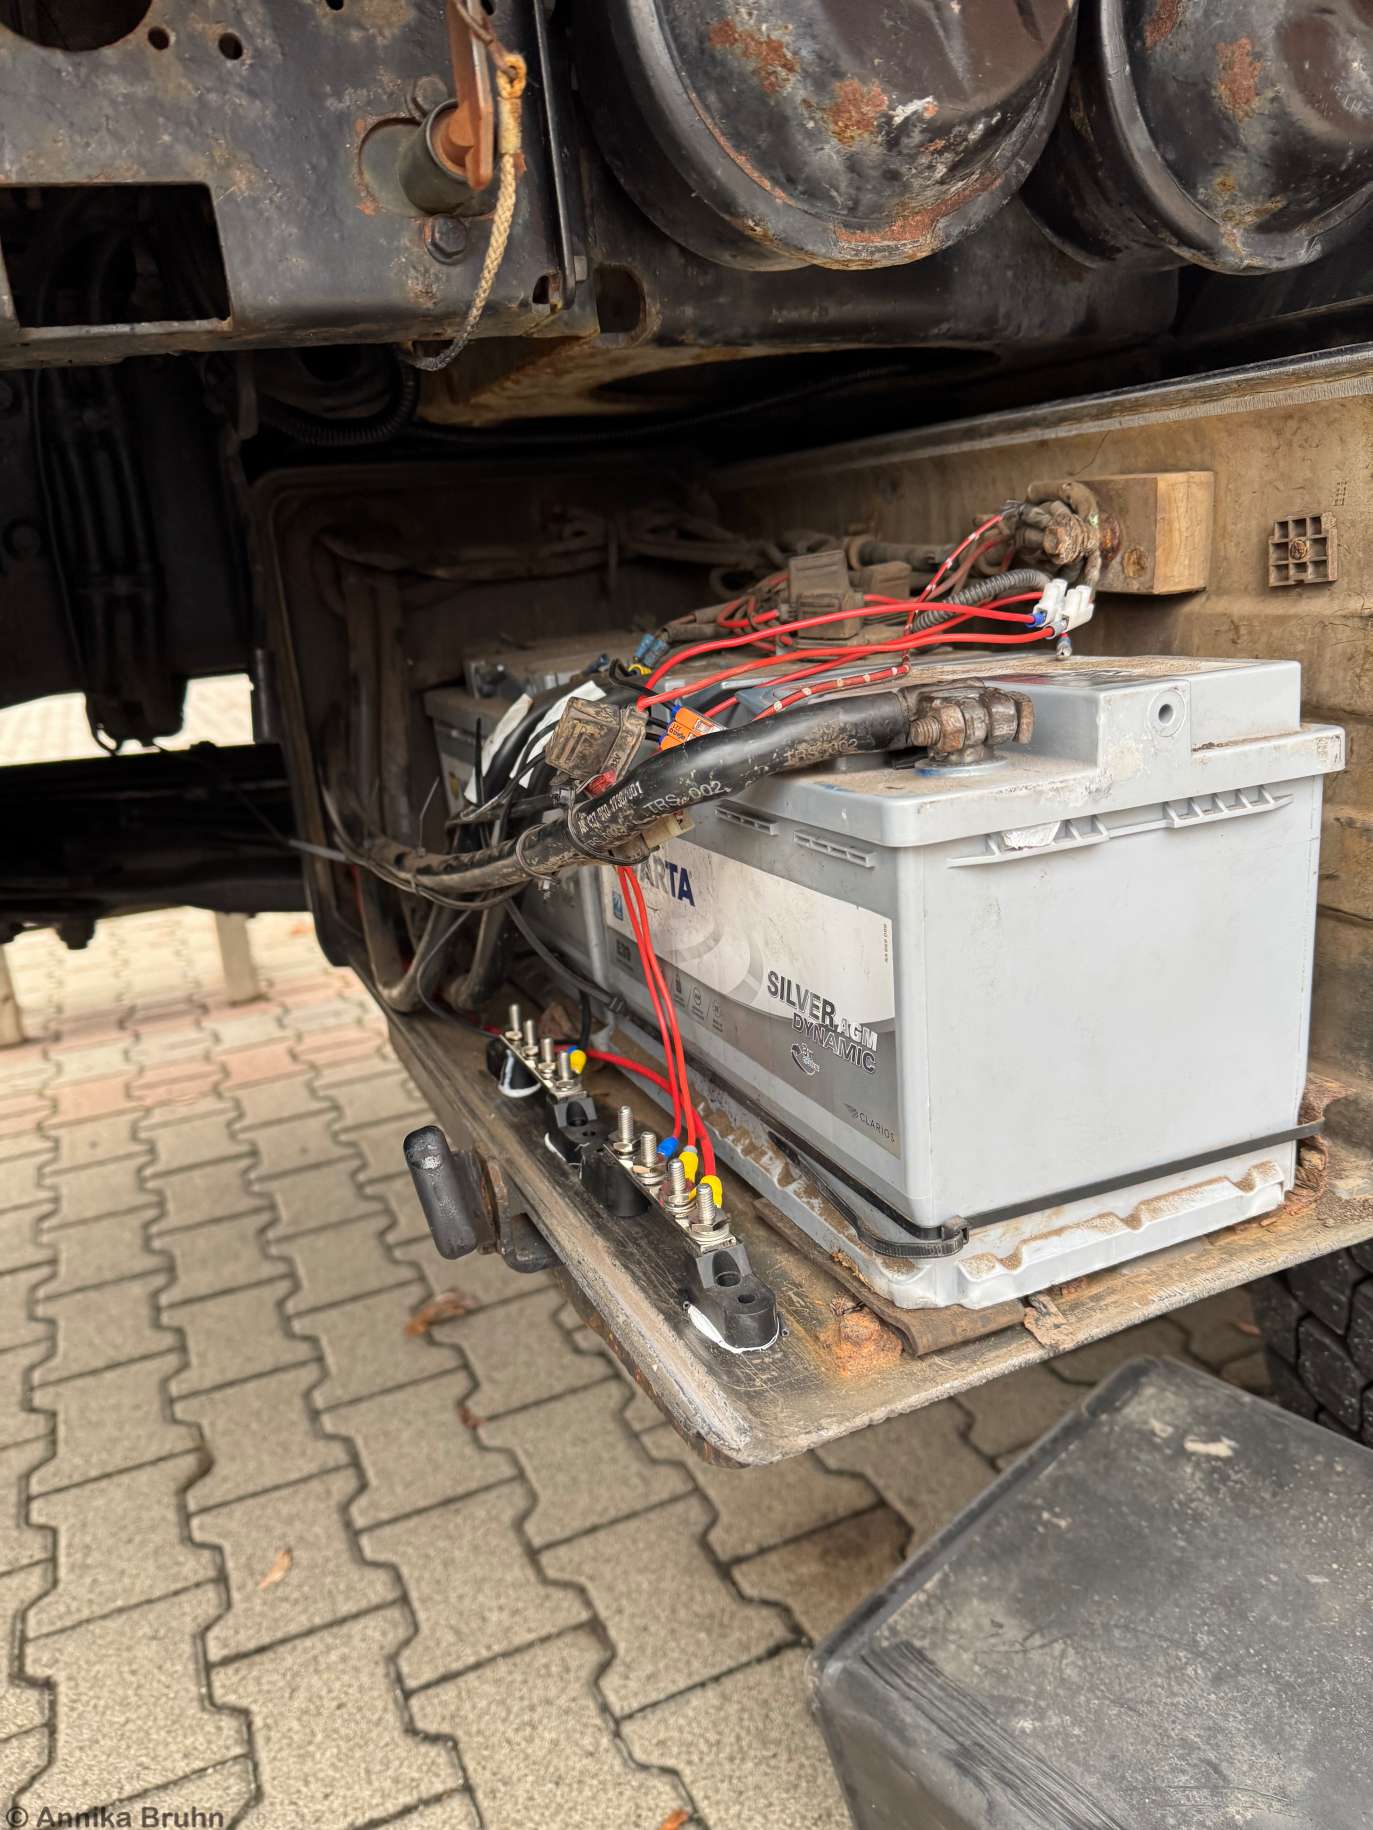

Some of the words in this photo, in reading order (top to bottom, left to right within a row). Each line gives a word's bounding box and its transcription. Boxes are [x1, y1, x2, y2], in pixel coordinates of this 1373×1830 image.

[766, 969, 836, 1028] SILVER
[791, 1011, 877, 1075] DYNAMIC
[837, 1017, 878, 1051] AGM
[859, 1112, 895, 1144] CLARIOS
